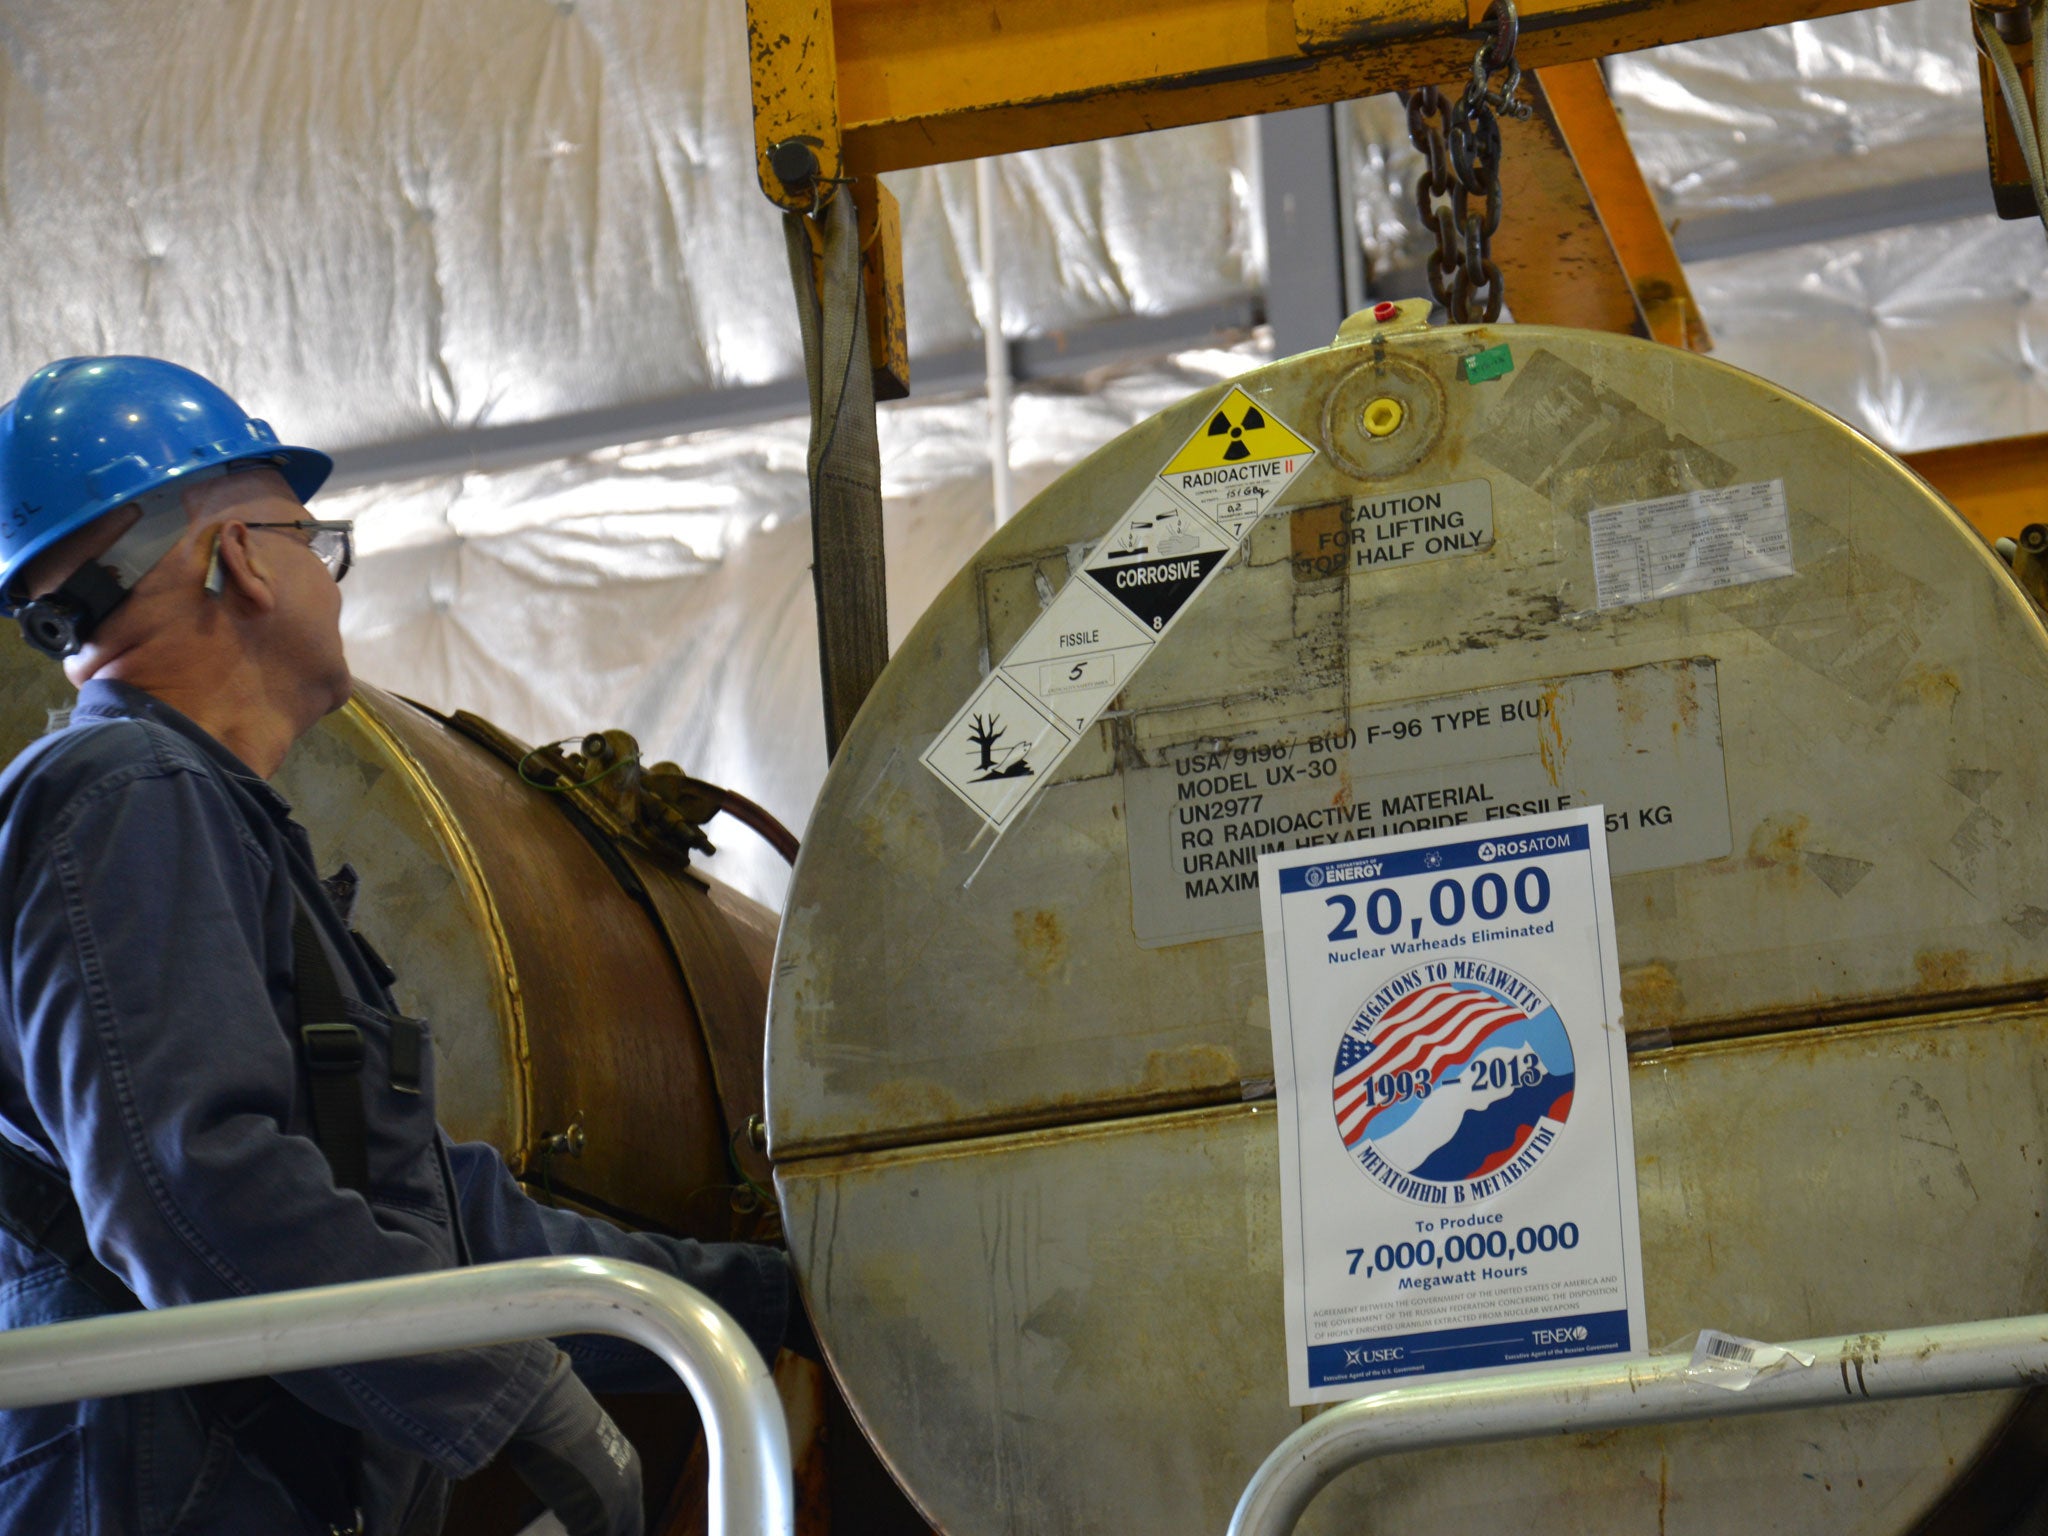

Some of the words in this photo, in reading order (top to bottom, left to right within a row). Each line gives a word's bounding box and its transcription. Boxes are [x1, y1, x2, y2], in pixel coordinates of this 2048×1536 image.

[1183, 462, 1280, 489] RADIOACTIVE
[1285, 459, 1293, 473] II
[1340, 493, 1441, 524] CAUTION
[1233, 523, 1242, 536] 7
[1319, 527, 1365, 550] FOR
[1377, 511, 1464, 540] LIFTING
[1301, 552, 1348, 575] TOP
[1357, 541, 1414, 566] HALF
[1425, 530, 1483, 554] ONLY
[1116, 560, 1200, 589] CORROSIVE
[1153, 616, 1162, 630] 8
[1059, 629, 1099, 648] FISSILE
[1068, 662, 1088, 681] 5
[1076, 718, 1084, 730] 7
[1309, 727, 1357, 754] B(U)
[1367, 718, 1422, 744] F-96
[1431, 707, 1491, 733] TYPE
[1501, 698, 1550, 722] B(U)
[1177, 772, 1257, 800] MODEL
[1266, 758, 1337, 786] UX-30
[1179, 794, 1264, 825] UN2977
[1181, 828, 1213, 849] RQ
[1224, 802, 1372, 843] RADIOACTIVE
[1382, 784, 1493, 817] MATERIAL
[1639, 805, 1673, 828] KG
[1497, 834, 1570, 857] ROSATOM
[1326, 863, 1383, 883] ENERGY
[1325, 866, 1551, 942] 20,000
[1328, 946, 1386, 964] Nuclear
[1391, 934, 1466, 956] Warheads
[1472, 922, 1555, 943] Eliminated
[1352, 969, 1422, 1037] MEGATONS
[1425, 962, 1447, 983] TO
[1453, 961, 1542, 1013] MEGAWATTS
[1363, 1068, 1433, 1107] 1993
[1471, 1053, 1543, 1093] 2013
[1357, 1145, 1447, 1204] МЕГАТОННЫ
[1454, 1185, 1465, 1203] В
[1470, 1126, 1556, 1201] МЕГАВАТТЫ
[1415, 1220, 1434, 1233] To
[1440, 1211, 1503, 1230] Produce
[1346, 1222, 1579, 1280] 7,000,000,000
[1398, 1270, 1476, 1291] Megawatt
[1482, 1264, 1528, 1280] Hours
[1313, 1306, 1358, 1318] AGREEMENT
[1360, 1301, 1393, 1312] BETWEEN
[1396, 1299, 1409, 1307] THE
[1411, 1293, 1464, 1305] GOVERNMENT
[1495, 1287, 1522, 1296] UNITED
[1524, 1284, 1550, 1293] STATES
[1551, 1281, 1562, 1290] OF
[1564, 1278, 1599, 1289] AMERICA
[1600, 1275, 1617, 1284] AND
[1313, 1321, 1328, 1329] THE
[1331, 1314, 1382, 1327] GOVERNMENT
[1398, 1310, 1412, 1318] THE
[1415, 1306, 1447, 1317] RUSSIAN
[1449, 1301, 1495, 1313] FEDERATION
[1498, 1295, 1550, 1307] CONCERNING
[1569, 1286, 1618, 1299] DISPOSITION
[1314, 1332, 1325, 1340] OF
[1327, 1329, 1353, 1338] HIGHLY
[1356, 1324, 1393, 1335] ENRICHED
[1395, 1319, 1432, 1330] URANIUM
[1434, 1314, 1477, 1326] EXTRACTED
[1479, 1312, 1502, 1321] FROM
[1503, 1307, 1539, 1318] NUCLEAR
[1541, 1303, 1580, 1314] WEAPONS
[1532, 1327, 1573, 1346] TENEX
[1363, 1347, 1404, 1363] USEC
[1531, 1350, 1546, 1359] Agent
[1564, 1346, 1585, 1354] Russian
[1586, 1342, 1618, 1352] Government
[1349, 1371, 1364, 1379] Agent
[1394, 1364, 1425, 1374] Government
